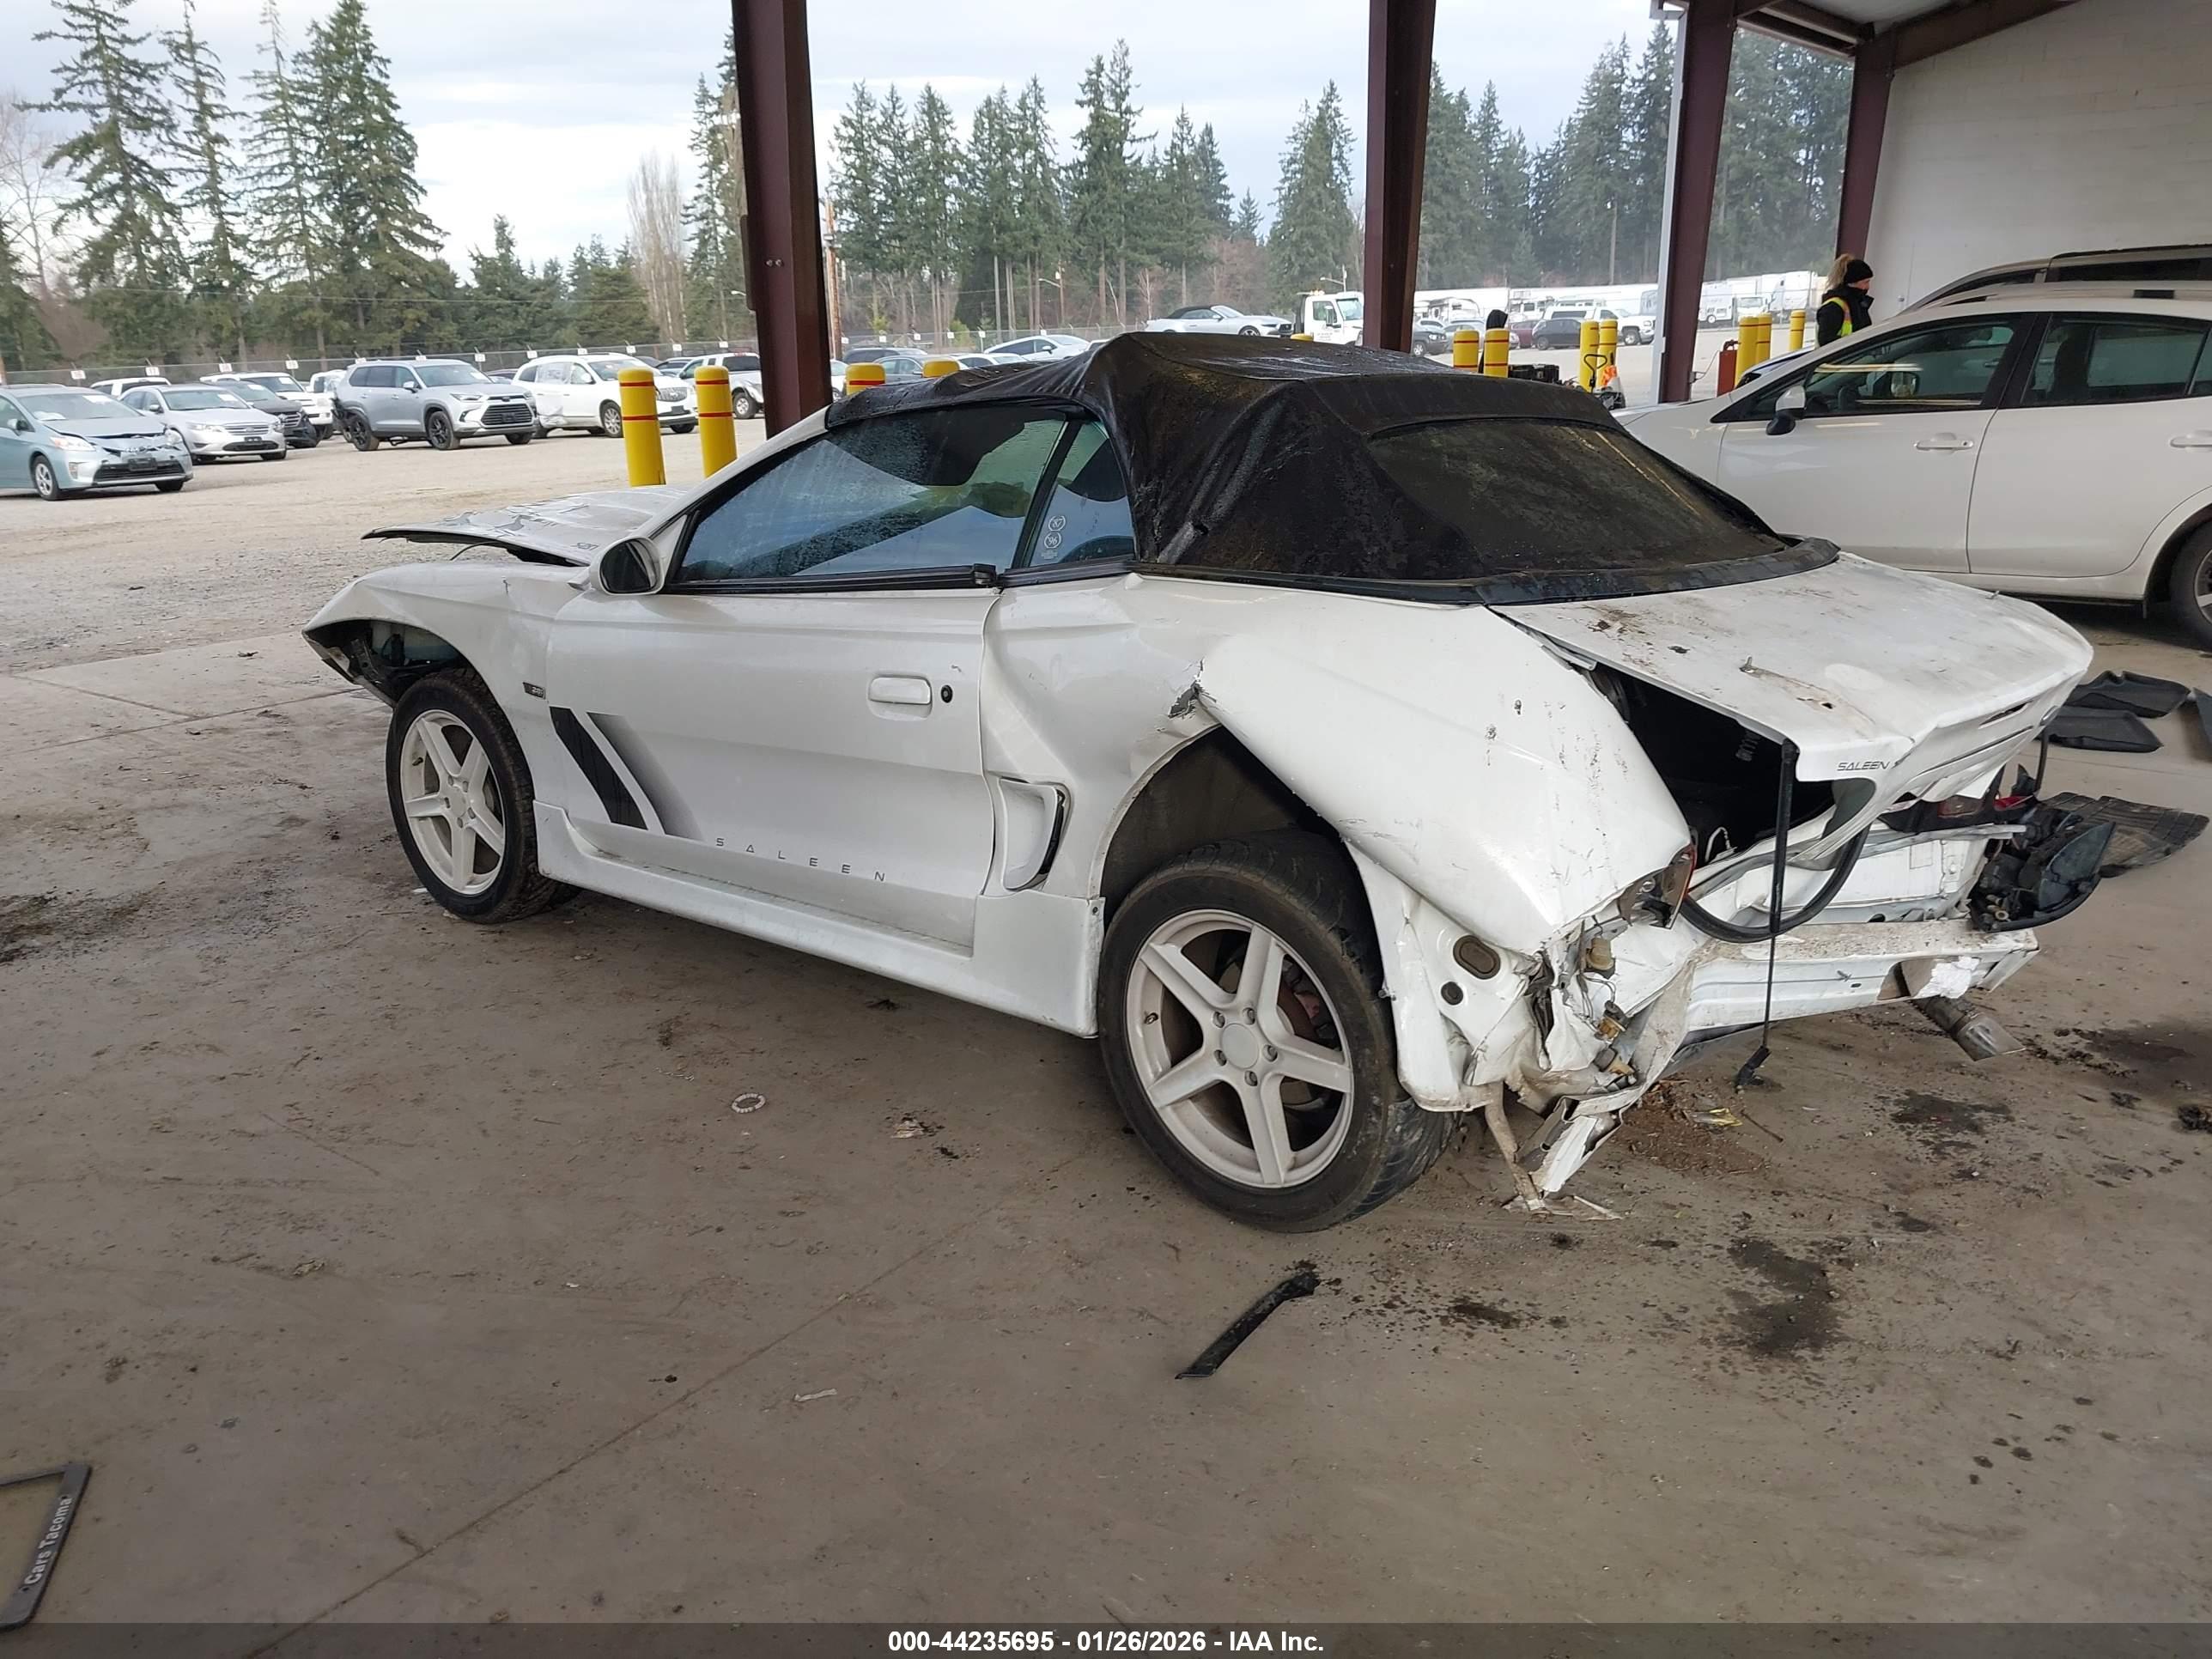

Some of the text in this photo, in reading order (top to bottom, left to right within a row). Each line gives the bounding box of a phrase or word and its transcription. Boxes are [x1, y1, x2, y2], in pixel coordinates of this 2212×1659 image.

[1837, 761, 1891, 771] SALEEN
[716, 837, 886, 883] SALEEN
[24, 1498, 73, 1585] Cars Tacoma
